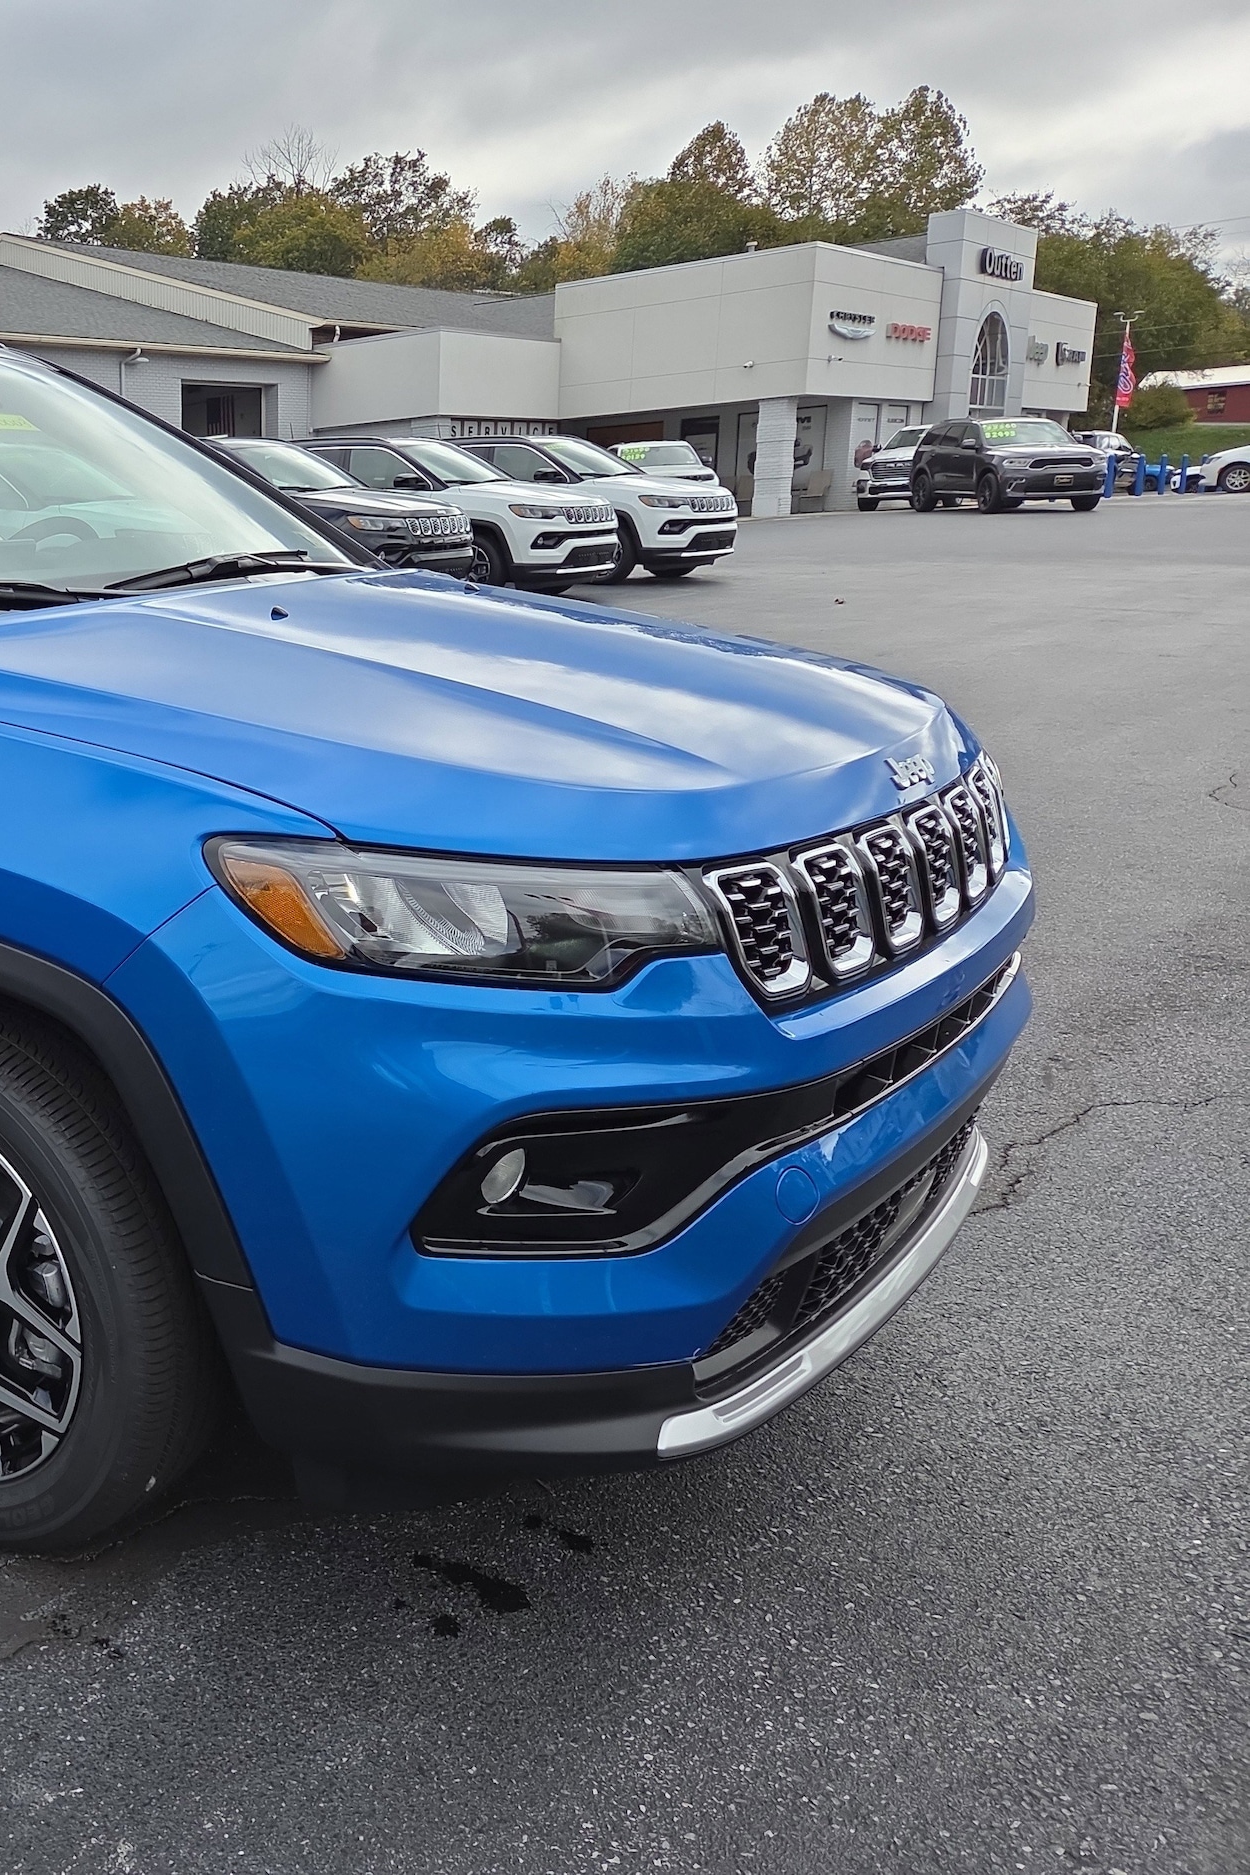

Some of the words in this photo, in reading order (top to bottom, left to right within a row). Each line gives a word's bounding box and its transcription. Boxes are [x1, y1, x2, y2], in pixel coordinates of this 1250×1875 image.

[981, 247, 1024, 281] Outten
[886, 322, 931, 342] DODGE
[450, 425, 554, 437] SERVICE
